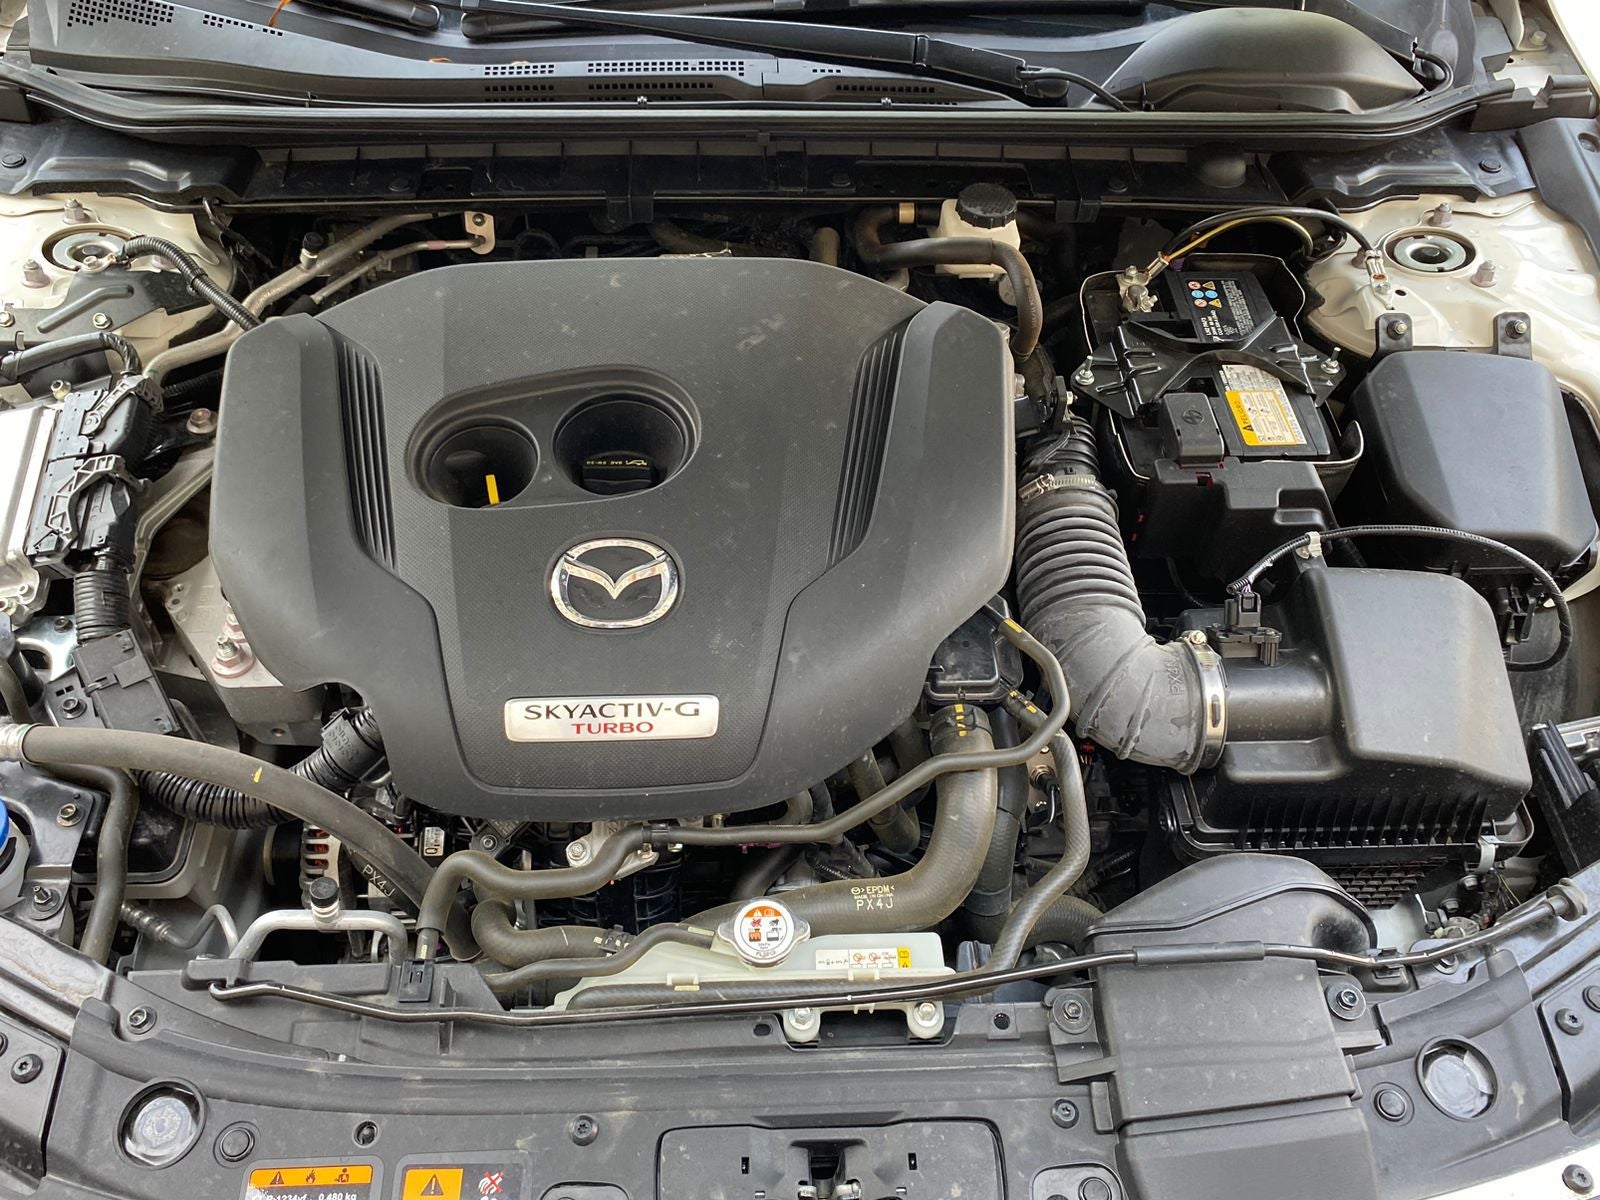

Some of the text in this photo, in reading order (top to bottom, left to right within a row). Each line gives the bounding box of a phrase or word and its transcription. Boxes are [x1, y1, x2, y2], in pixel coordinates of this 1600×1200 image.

[524, 702, 700, 720] SKYACTIV-G
[571, 722, 654, 735] TURBO
[362, 864, 395, 897] PX4J
[856, 897, 894, 911] PX4J
